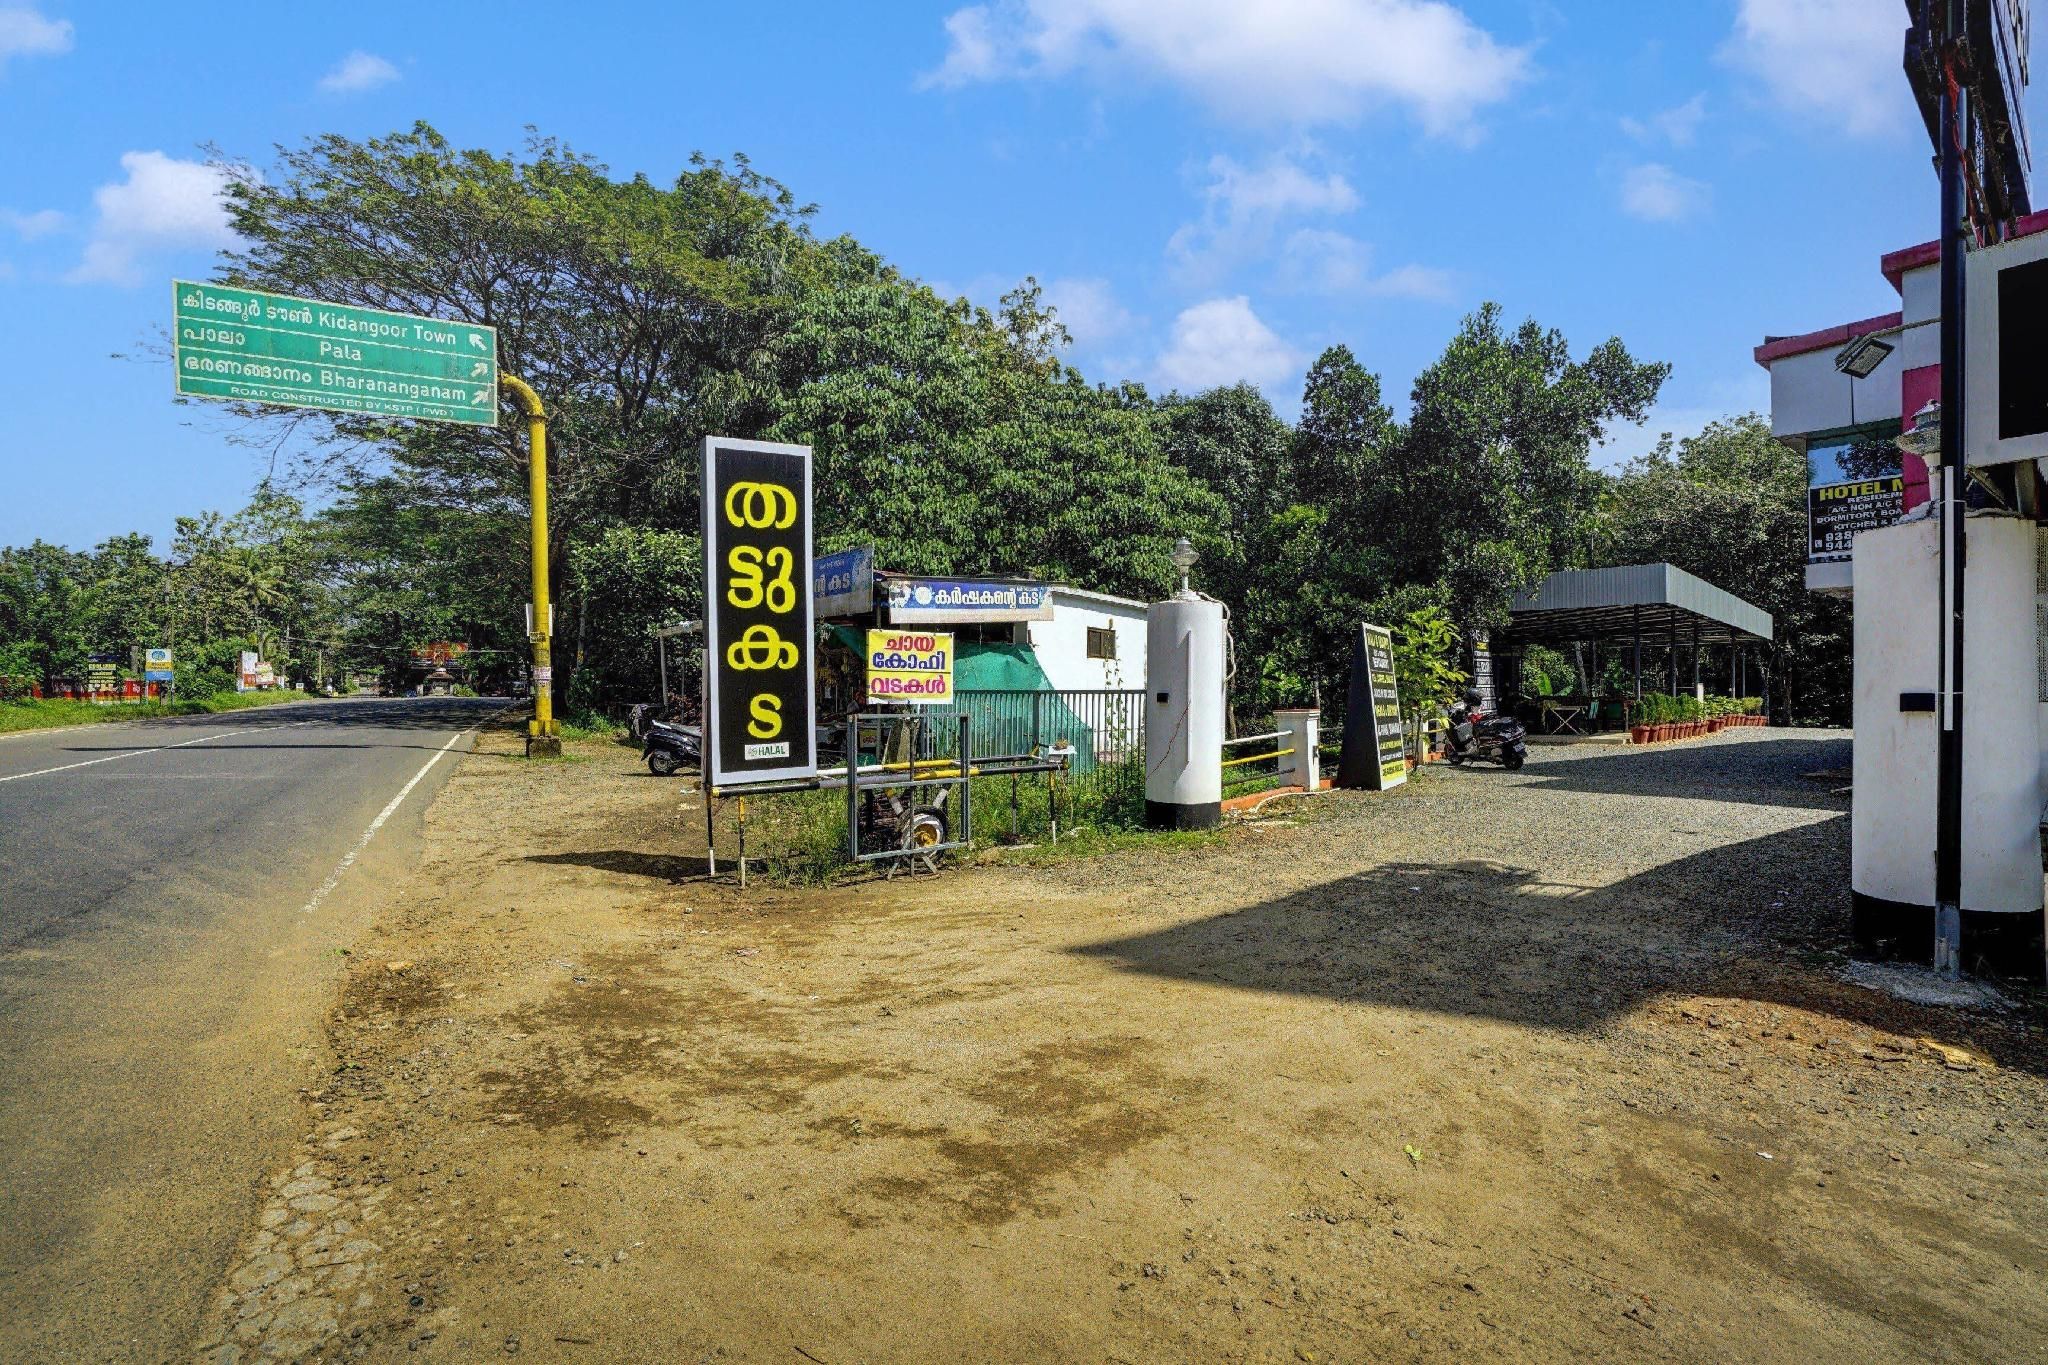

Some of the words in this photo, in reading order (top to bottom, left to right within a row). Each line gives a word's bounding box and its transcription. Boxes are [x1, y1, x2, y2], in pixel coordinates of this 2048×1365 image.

[183, 328, 246, 345] പാലാ
[319, 312, 408, 338] Kidangoor
[413, 325, 457, 345] Town
[320, 341, 362, 361] Pala
[184, 356, 313, 383] ഭരണങ്ങാനം
[321, 370, 466, 401] Bharananganam
[231, 386, 268, 398] ROAD
[271, 391, 362, 407] CONSTRUCTED
[366, 401, 381, 409] BY
[1819, 481, 1887, 501] HOTEL
[1850, 502, 1873, 511] NON
[1816, 510, 1877, 524] DORMITORY
[1834, 519, 1878, 531] KITCHEN
[1018, 589, 1039, 605] കട
[884, 635, 936, 653] ചായ
[873, 650, 946, 670] കോഫി
[871, 674, 946, 694] വടകൾ
[758, 745, 786, 756] HALAL
